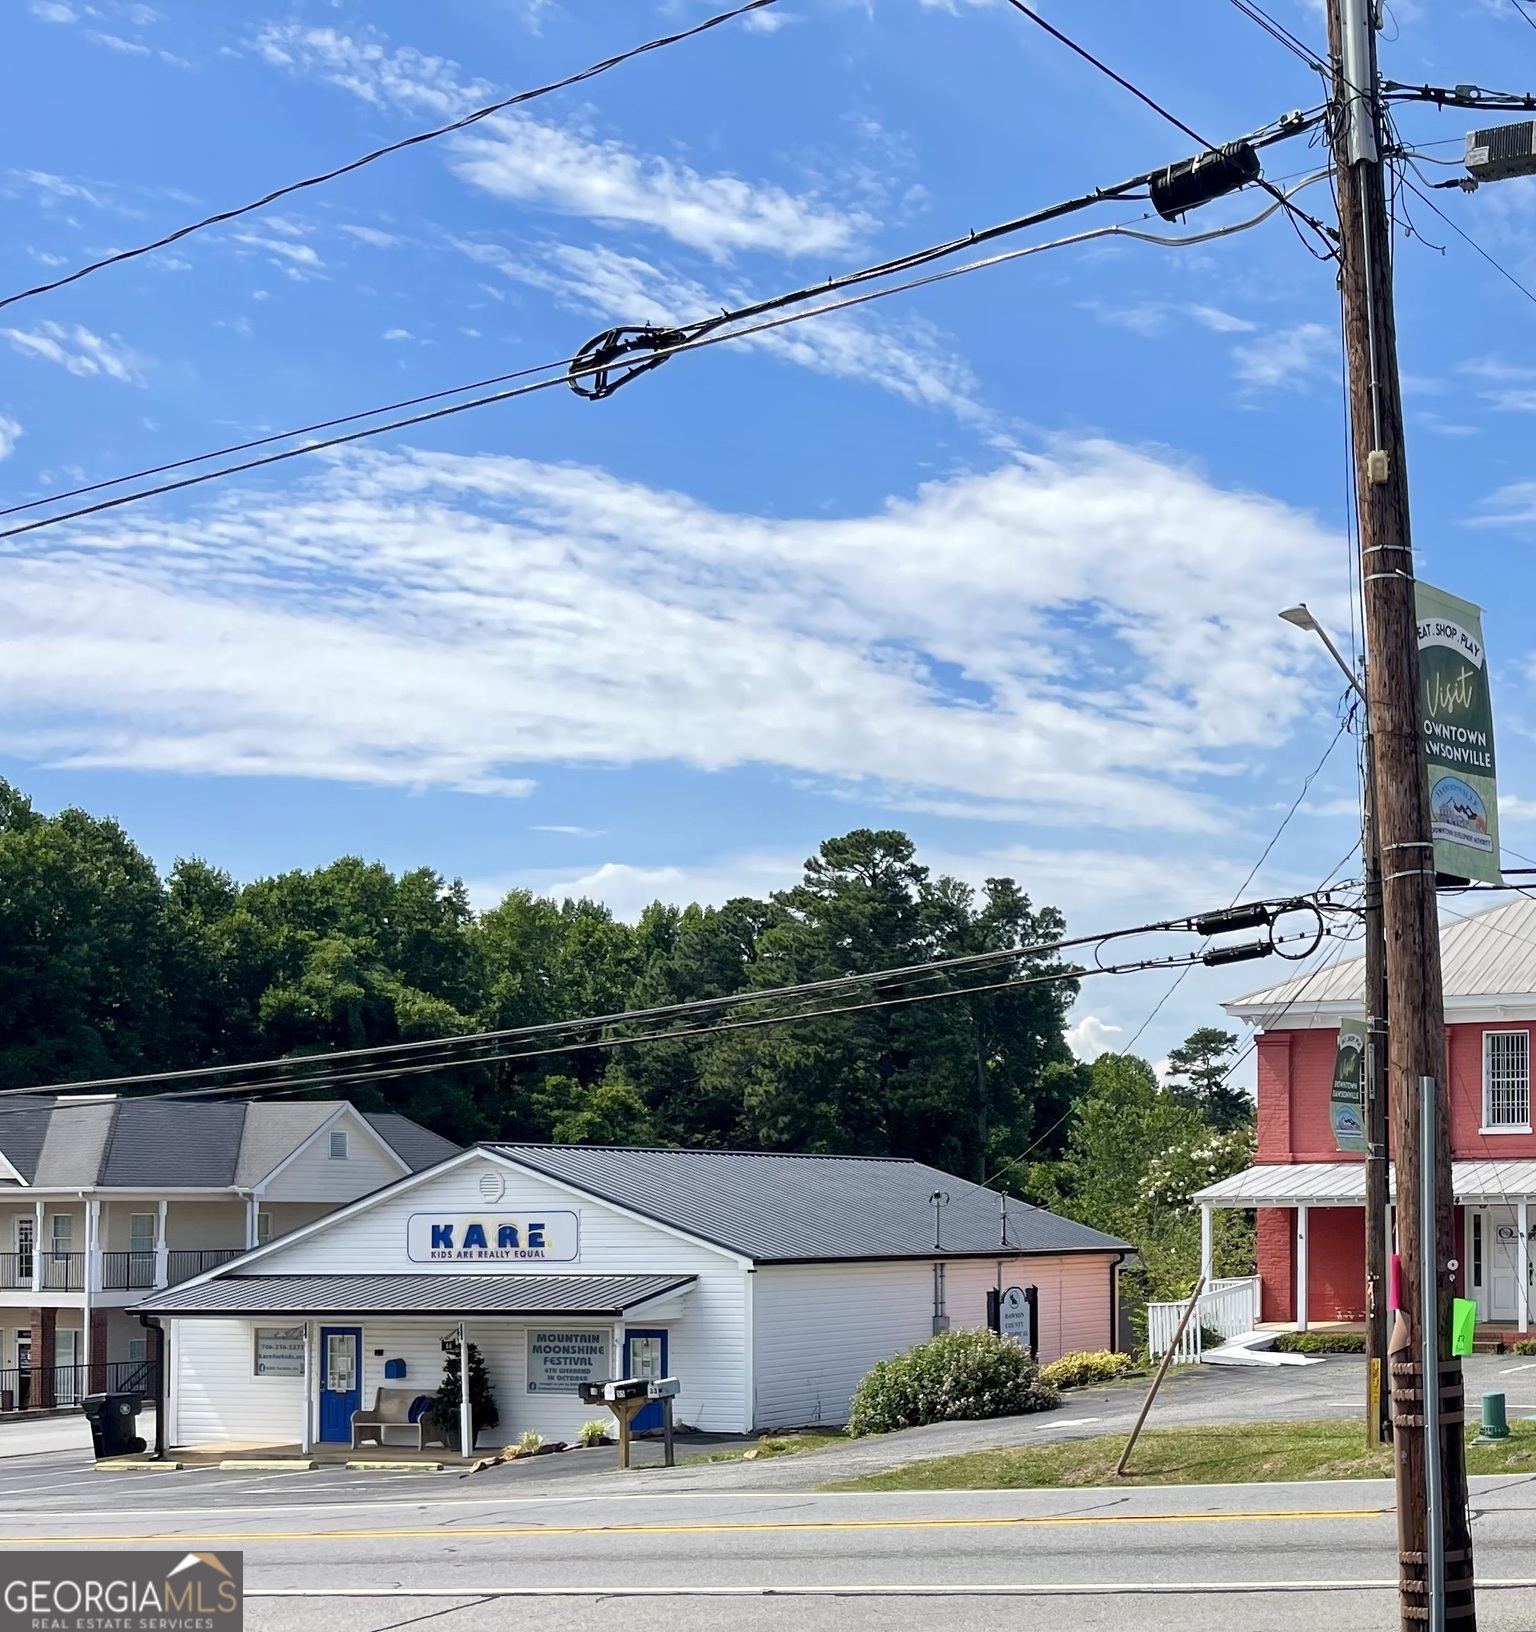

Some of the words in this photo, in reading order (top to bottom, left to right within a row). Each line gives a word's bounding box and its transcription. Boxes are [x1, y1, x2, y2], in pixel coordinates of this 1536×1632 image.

[1460, 633, 1480, 657] PLAY
[1426, 665, 1474, 718] Visit
[1423, 720, 1487, 747] OWNTOWN
[1425, 740, 1491, 768] WSONVILLE
[431, 1250, 452, 1259] KIDS
[457, 1250, 474, 1259] ARE
[478, 1250, 510, 1258] REALLY
[515, 1250, 545, 1258] EQUAL
[537, 1334, 600, 1343] MOUNTAIN
[532, 1345, 605, 1355] MOONSHINE
[543, 1356, 593, 1366] FESTIVAL
